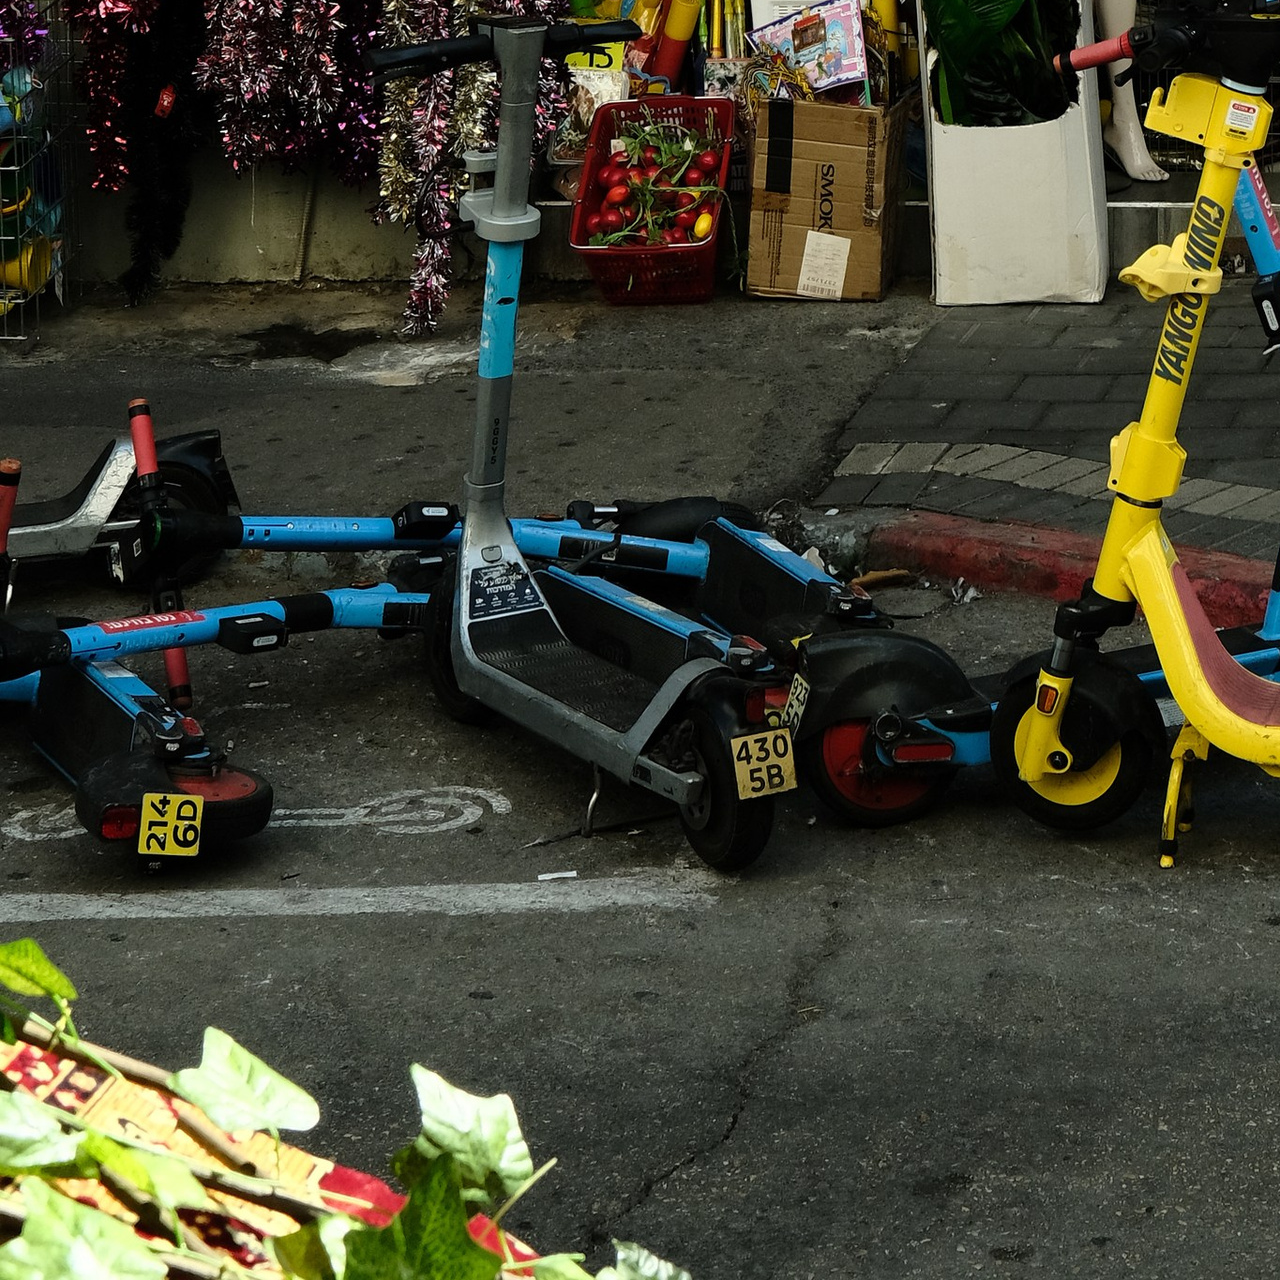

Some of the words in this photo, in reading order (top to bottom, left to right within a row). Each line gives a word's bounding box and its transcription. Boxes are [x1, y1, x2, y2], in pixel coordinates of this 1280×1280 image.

[818, 163, 835, 232] SMOK
[1154, 293, 1203, 387] YANGO
[736, 734, 789, 765] 430
[749, 764, 785, 793] 5B
[146, 795, 171, 851] 214
[172, 799, 199, 848] 6D
